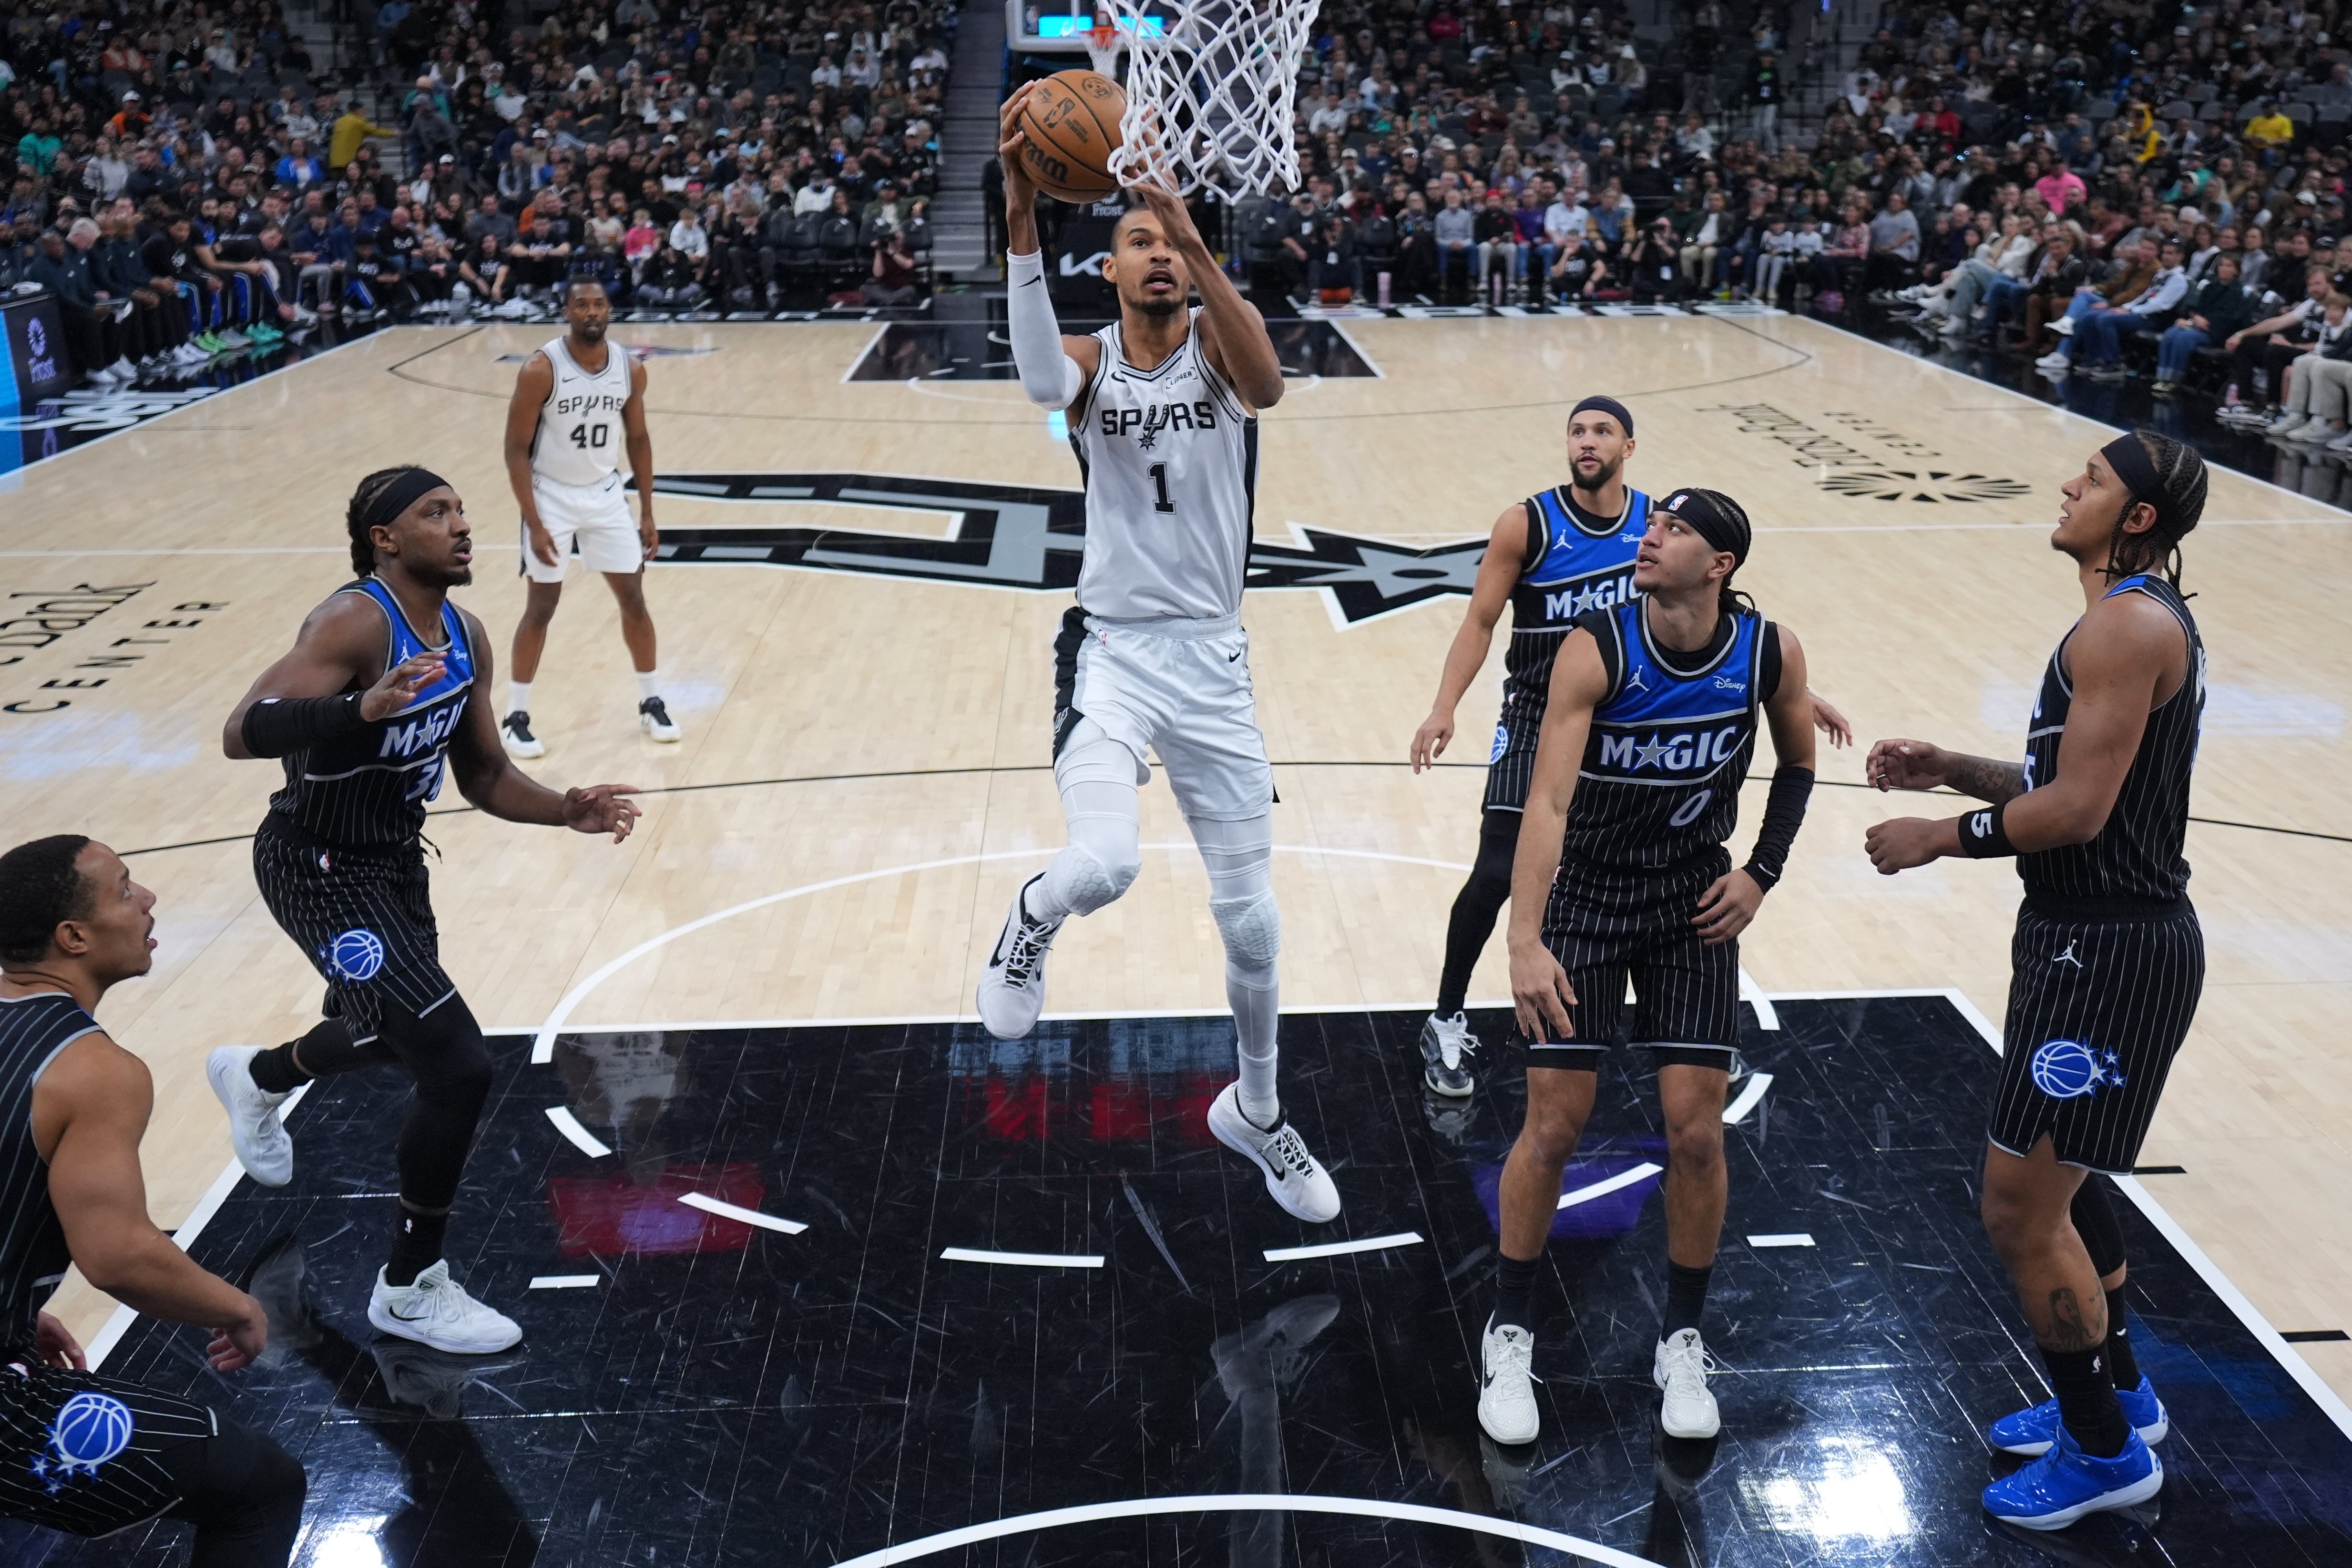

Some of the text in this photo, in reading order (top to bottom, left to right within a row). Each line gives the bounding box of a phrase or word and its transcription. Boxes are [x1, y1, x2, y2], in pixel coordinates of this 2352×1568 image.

[558, 396, 624, 418] SPURS
[1102, 401, 1216, 449] SPURS
[570, 423, 608, 449] 40
[1147, 461, 1176, 515] 1
[2, 601, 231, 712] CENTER
[1669, 789, 1712, 827] 0
[1971, 812, 1994, 839] 5
